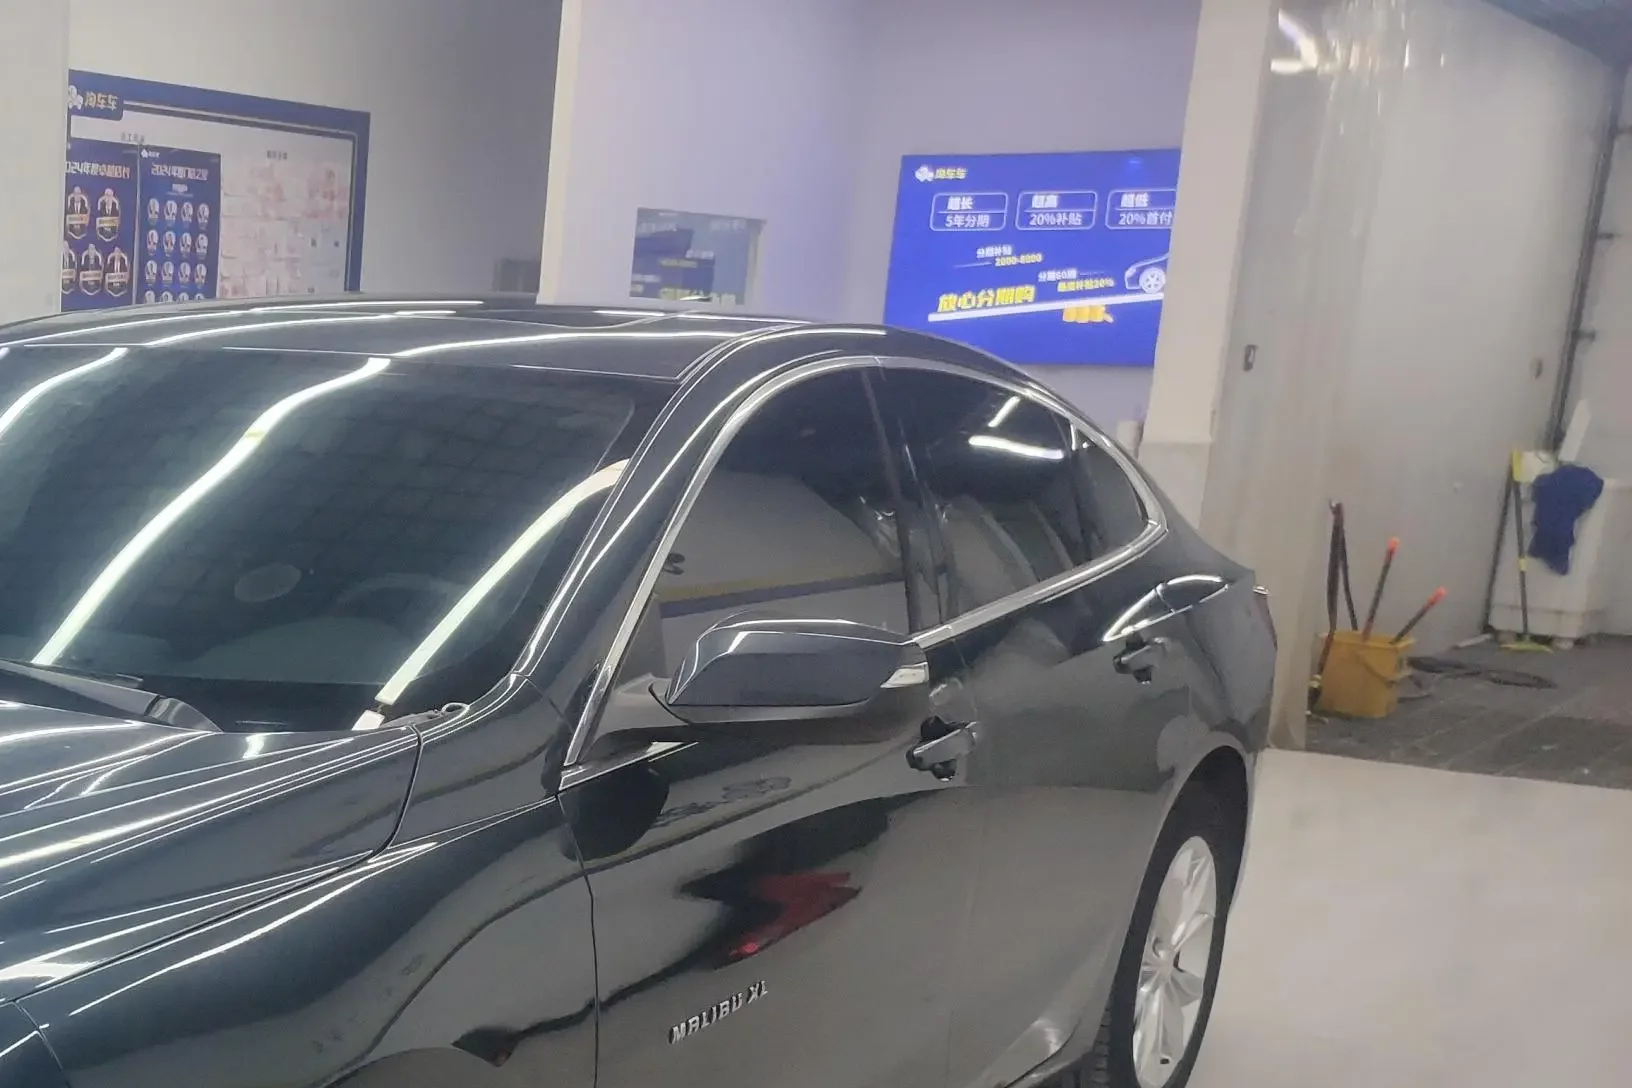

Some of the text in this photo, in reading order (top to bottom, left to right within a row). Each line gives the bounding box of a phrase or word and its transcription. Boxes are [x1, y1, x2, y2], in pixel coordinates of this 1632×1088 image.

[945, 214, 990, 228] 5年分期
[1029, 212, 1083, 226] 20%补贴
[1118, 211, 1173, 225] 20%首付
[670, 980, 768, 1044] MALIBU XL
